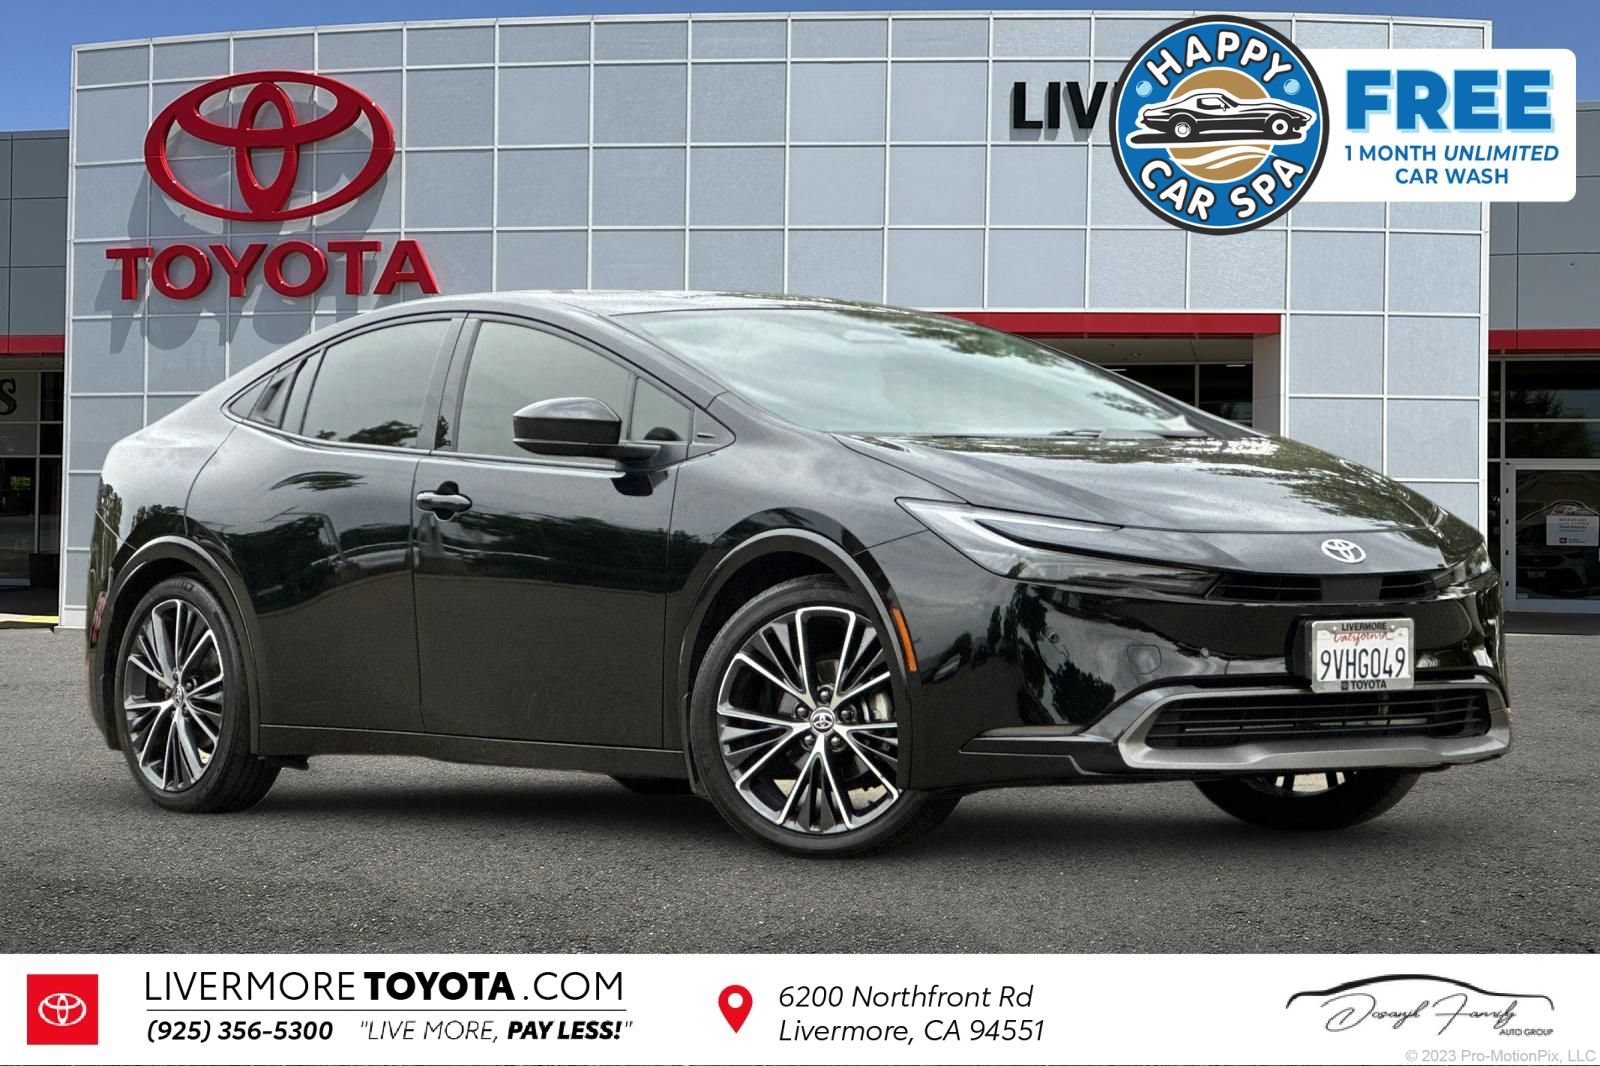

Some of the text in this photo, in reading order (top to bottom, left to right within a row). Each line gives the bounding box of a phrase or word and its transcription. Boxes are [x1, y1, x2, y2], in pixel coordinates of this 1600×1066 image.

[1013, 82, 1118, 129] LIV
[105, 240, 441, 300] TOYOTA
[1341, 622, 1387, 631] LIVERMORE
[1320, 647, 1406, 681] 9VHG049
[1351, 680, 1387, 690] TOYOTA
